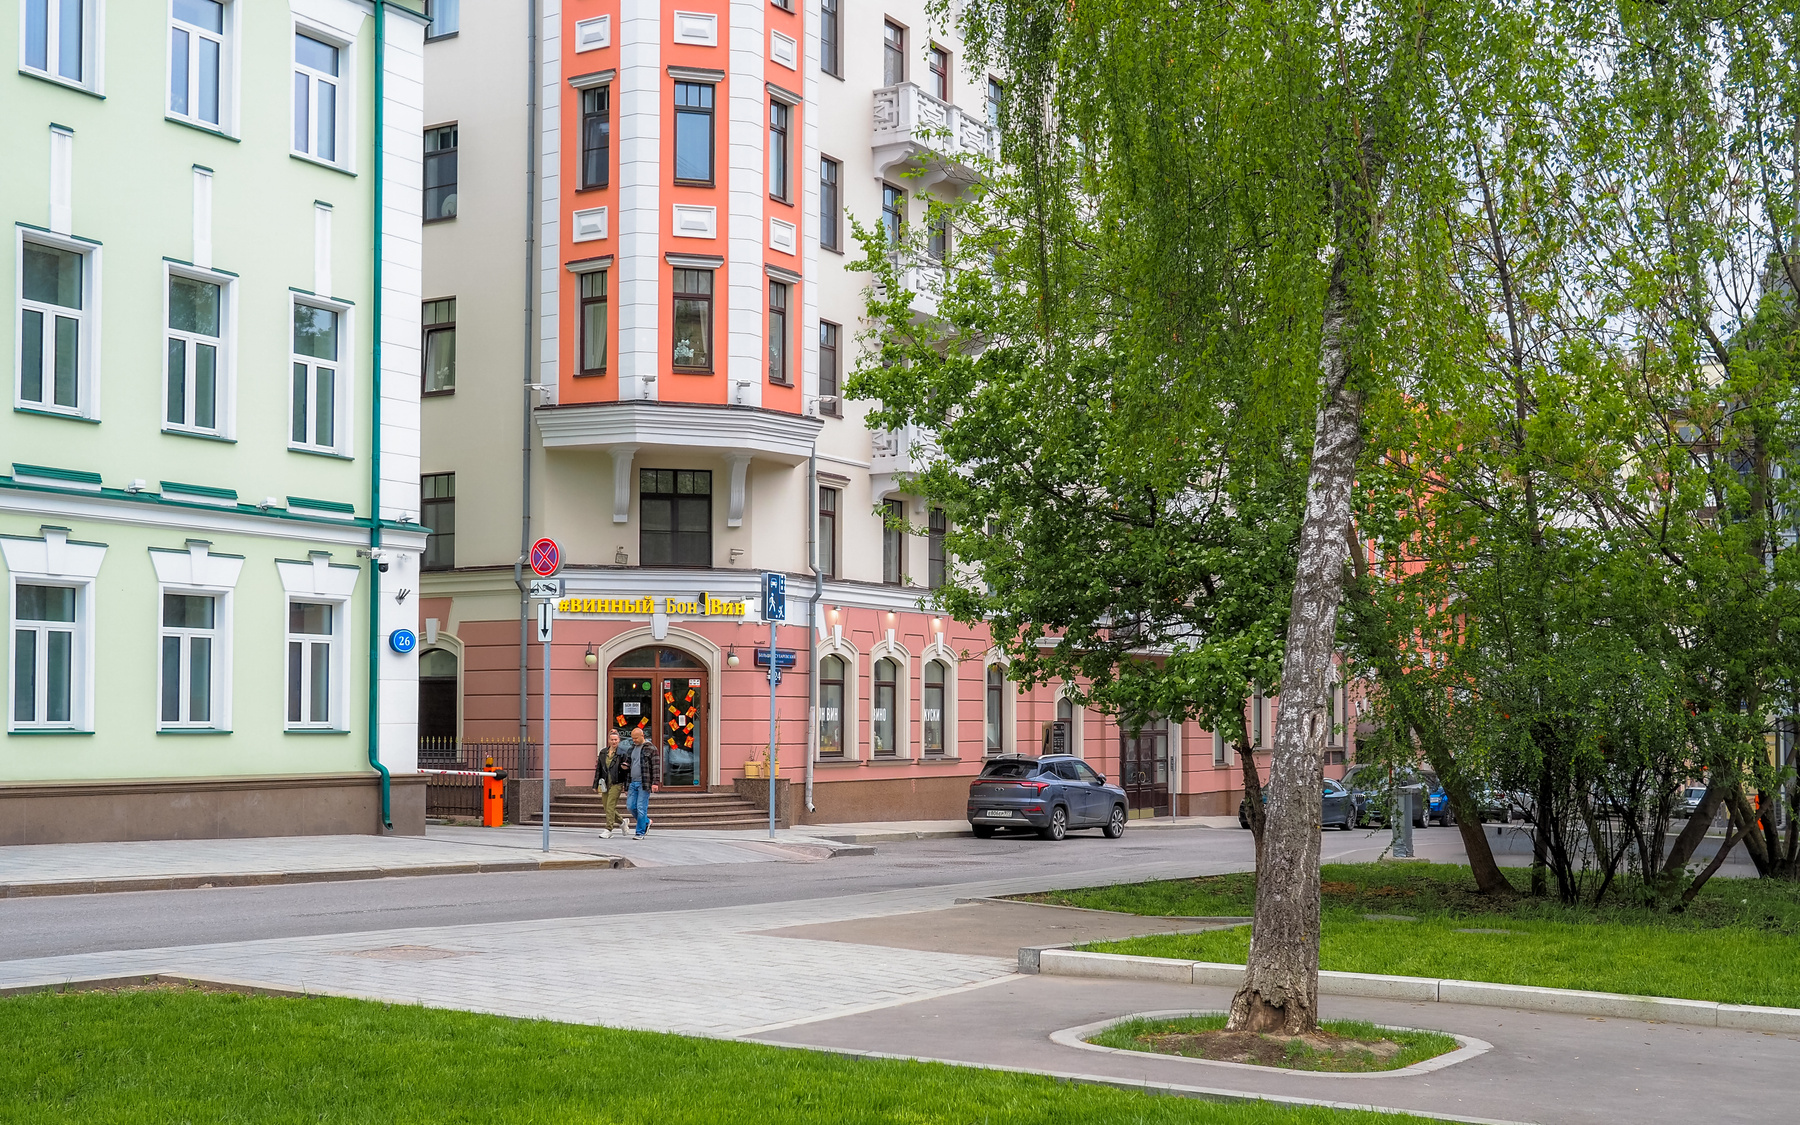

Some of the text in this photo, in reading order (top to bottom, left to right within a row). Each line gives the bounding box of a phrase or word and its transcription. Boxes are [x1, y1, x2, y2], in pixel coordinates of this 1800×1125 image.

[558, 595, 746, 616] #ВИННЫЙ Бон Вин
[398, 635, 411, 647] 26
[827, 708, 839, 721] ВИН
[924, 709, 940, 722] КУСКИ
